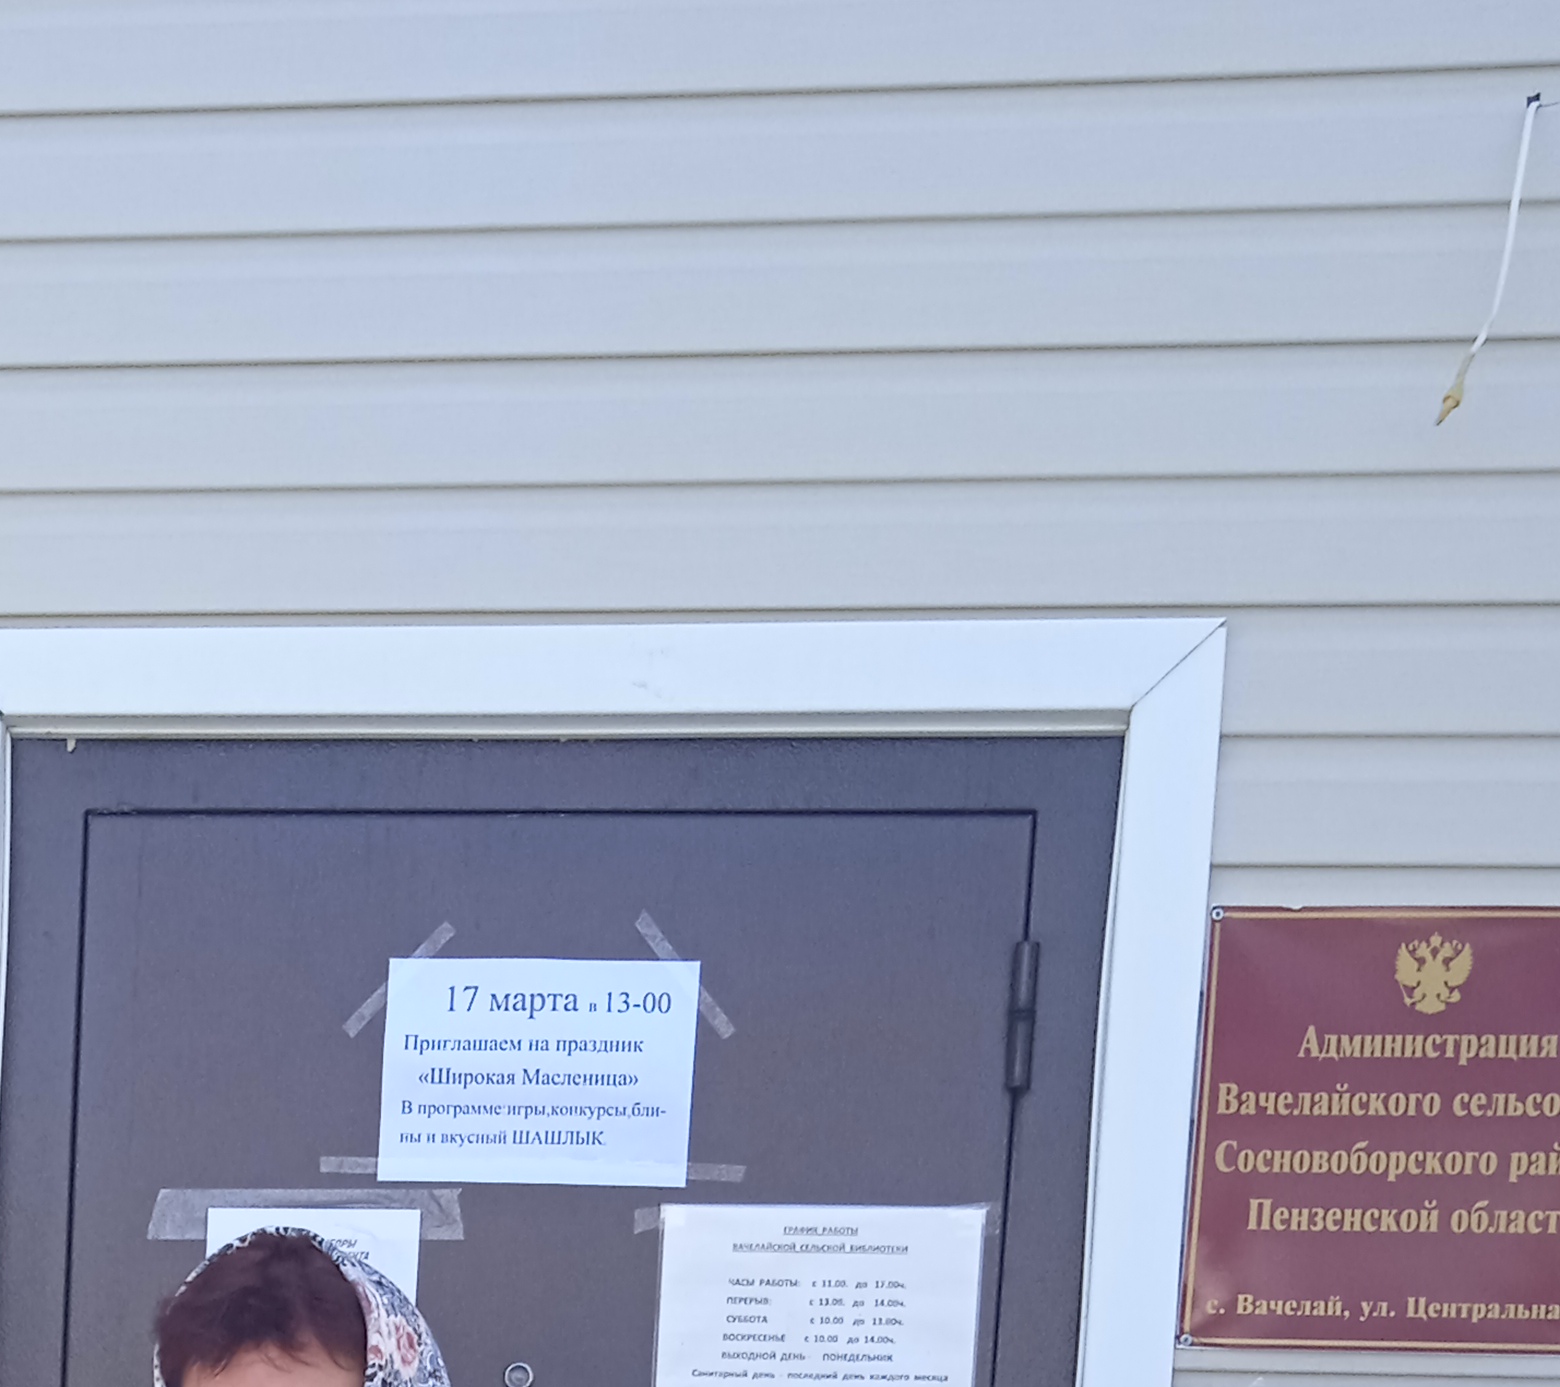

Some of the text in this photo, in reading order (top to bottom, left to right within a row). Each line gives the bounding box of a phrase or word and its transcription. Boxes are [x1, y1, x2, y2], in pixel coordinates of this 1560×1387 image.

[447, 985, 672, 1020] 17 марта в 13-00
[404, 1033, 645, 1057] Приглашаем на праздник
[1297, 1025, 1558, 1066] Администрация
[418, 1067, 639, 1090] «Широкая Масленица»
[401, 1100, 414, 1115] В
[1216, 1083, 1560, 1117] Вачелайского сельсо
[426, 1132, 437, 1144] и
[440, 1129, 508, 1148] вкусный
[1215, 1140, 1498, 1182] Сосновоборского
[1247, 1198, 1560, 1234] Пензенской област
[822, 1226, 859, 1237] РАБОТЫ
[854, 1281, 868, 1290] до
[851, 1300, 865, 1309] до
[1206, 1298, 1226, 1315] с.
[1236, 1293, 1351, 1319] Вачелай,
[1359, 1300, 1397, 1322] ул.
[726, 1315, 769, 1325] СУББОТА
[852, 1318, 866, 1327] до
[722, 1333, 786, 1343] ВОСКРЕСЕНЬЕ
[846, 1336, 860, 1345] до
[721, 1351, 894, 1363] ВЫХОДНОЙ ДЕНЬ ПОНЕДЕЛЬНИК
[691, 1368, 749, 1380] Санитарный
[787, 1371, 839, 1381] последний
